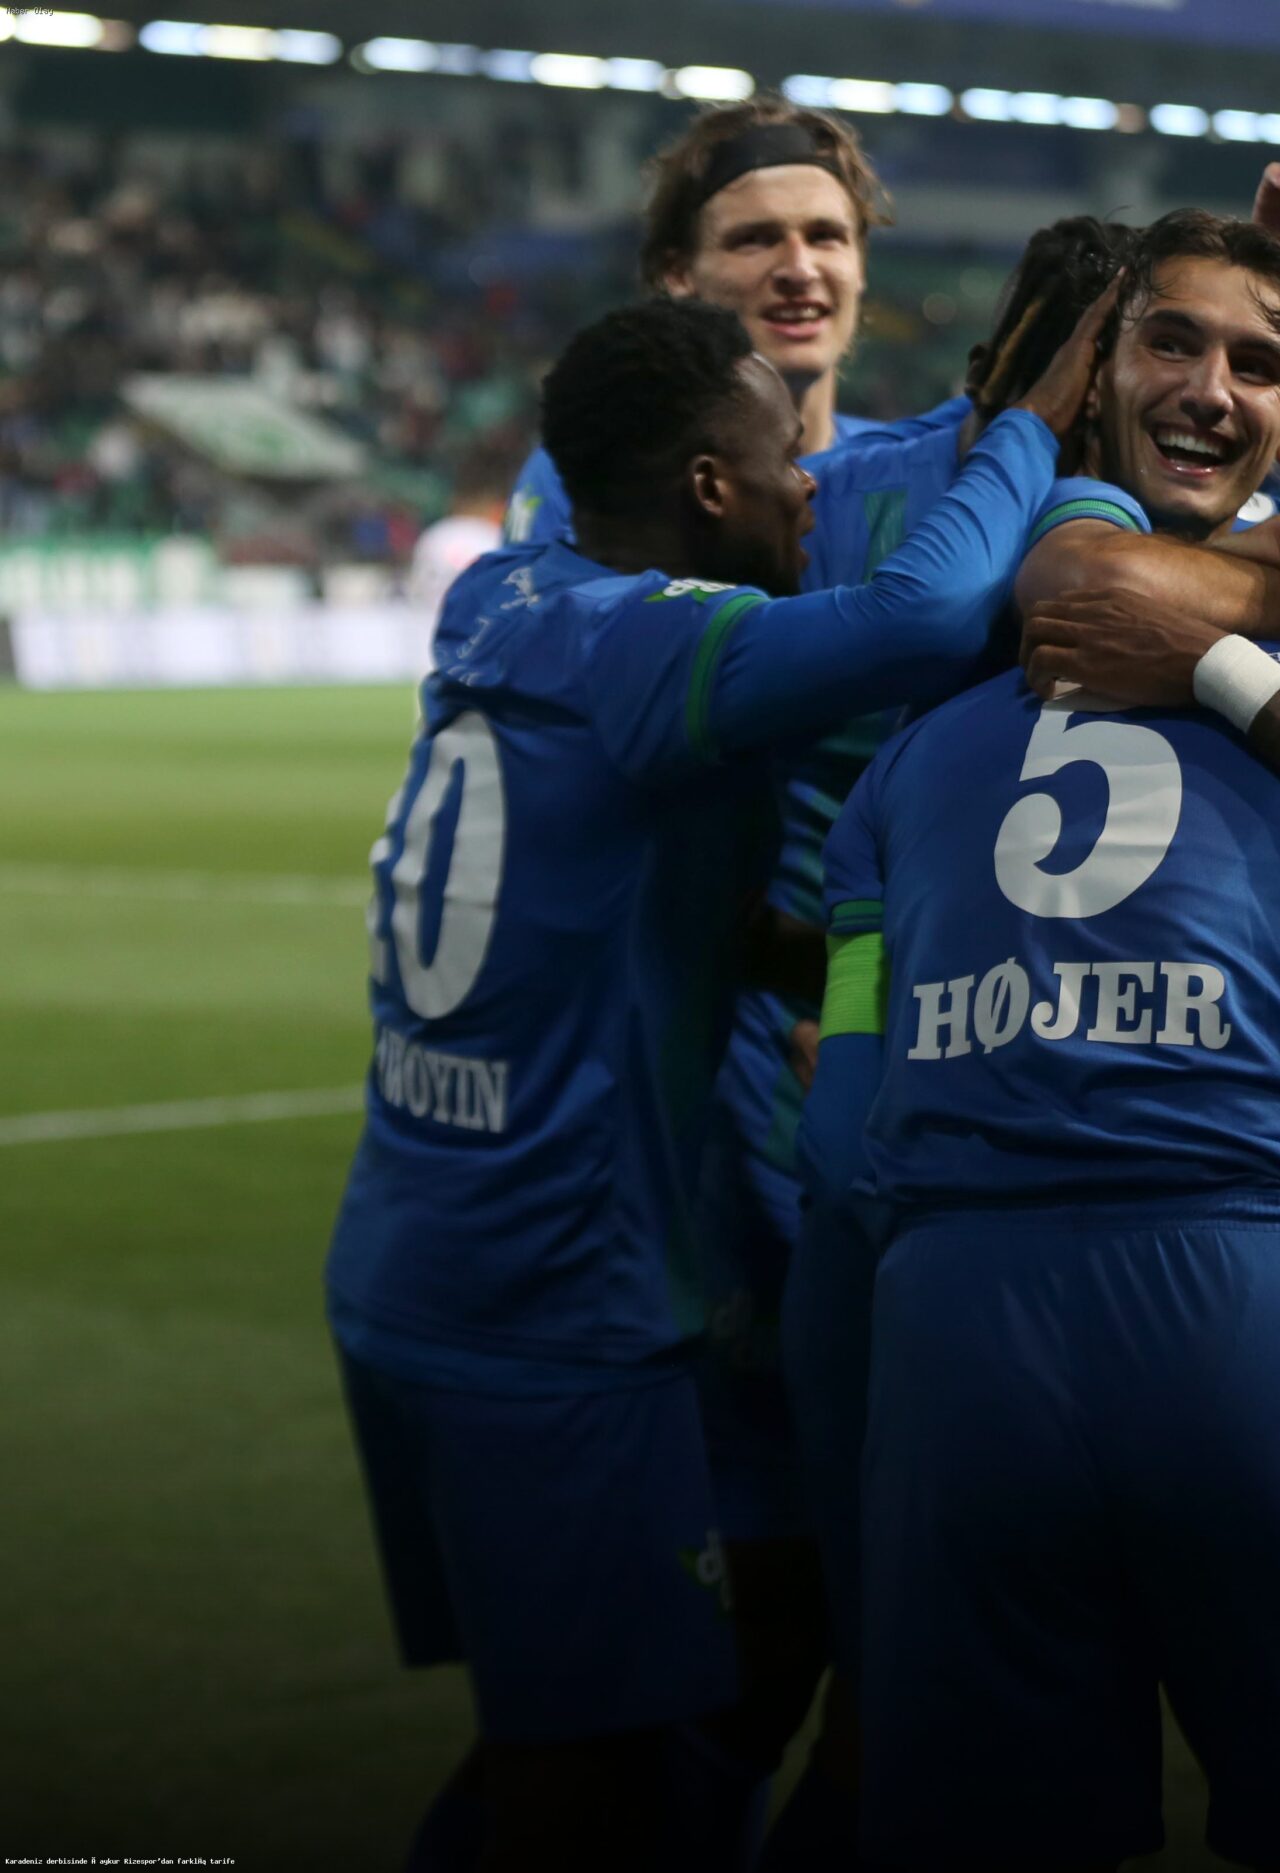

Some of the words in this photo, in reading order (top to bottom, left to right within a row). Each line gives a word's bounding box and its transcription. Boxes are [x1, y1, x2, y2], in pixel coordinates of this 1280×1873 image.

[368, 710, 506, 1019] 0
[994, 688, 1182, 918] 5
[907, 957, 1231, 1060] HØJER
